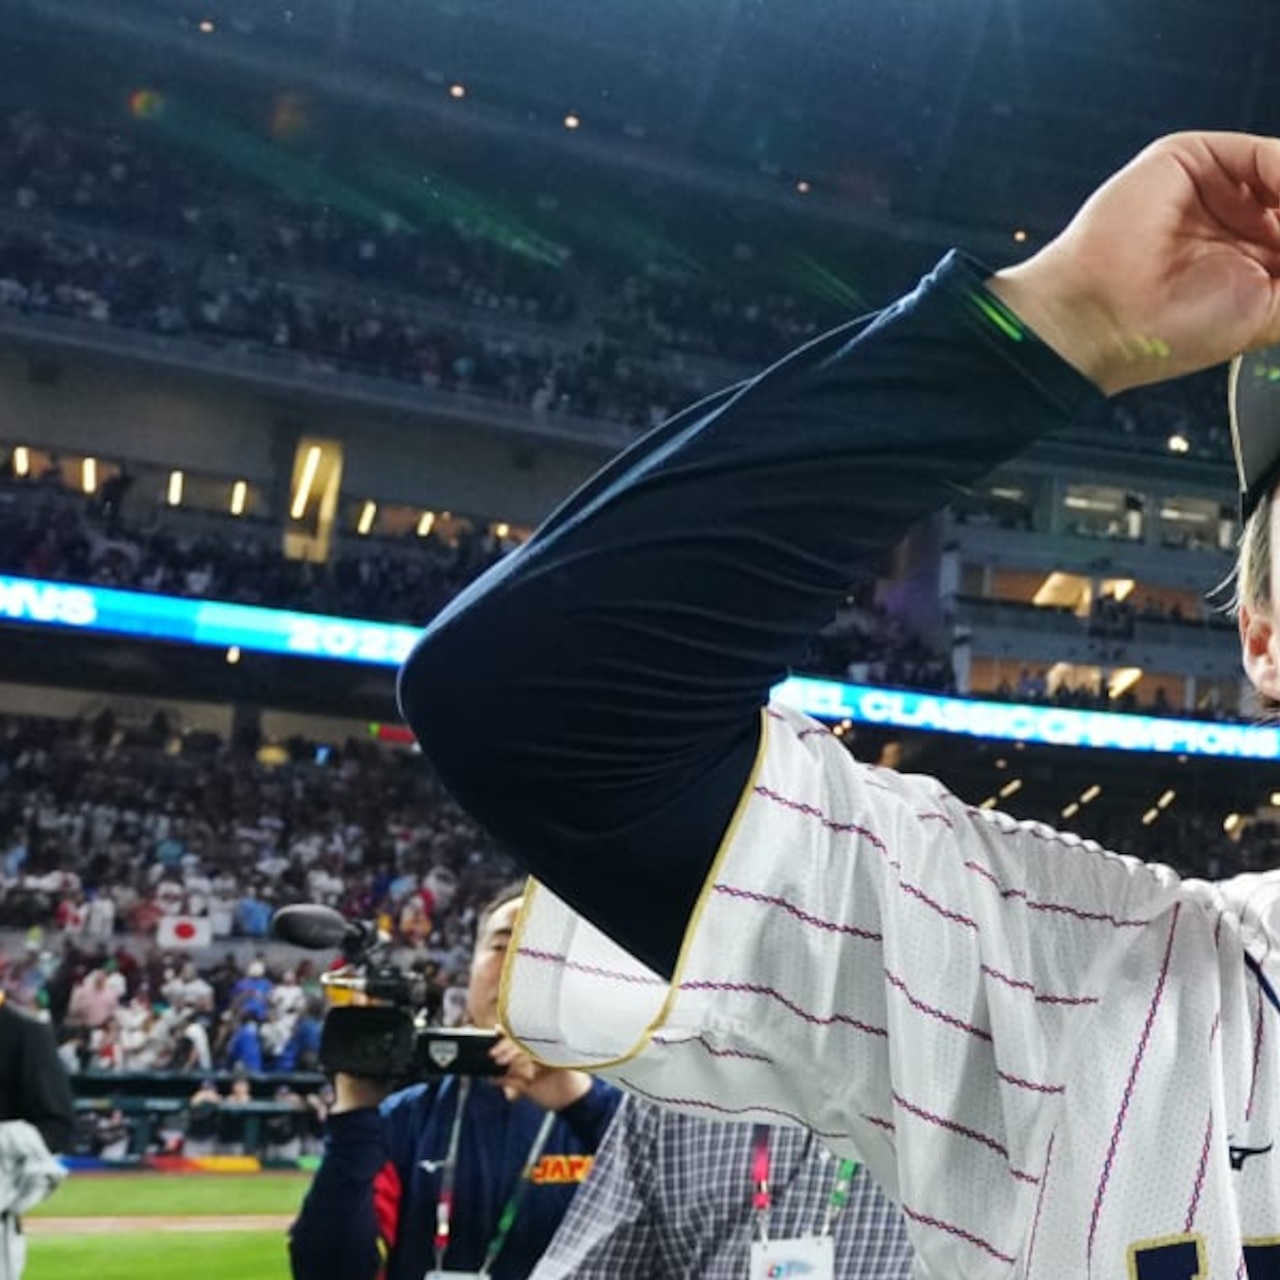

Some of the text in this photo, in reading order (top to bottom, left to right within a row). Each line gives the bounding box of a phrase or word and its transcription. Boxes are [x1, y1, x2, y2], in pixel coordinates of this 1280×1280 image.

[862, 693, 1035, 738] CLASSIC
[1038, 710, 1278, 756] CHAMPIONS
[532, 1154, 594, 1185] JAP
